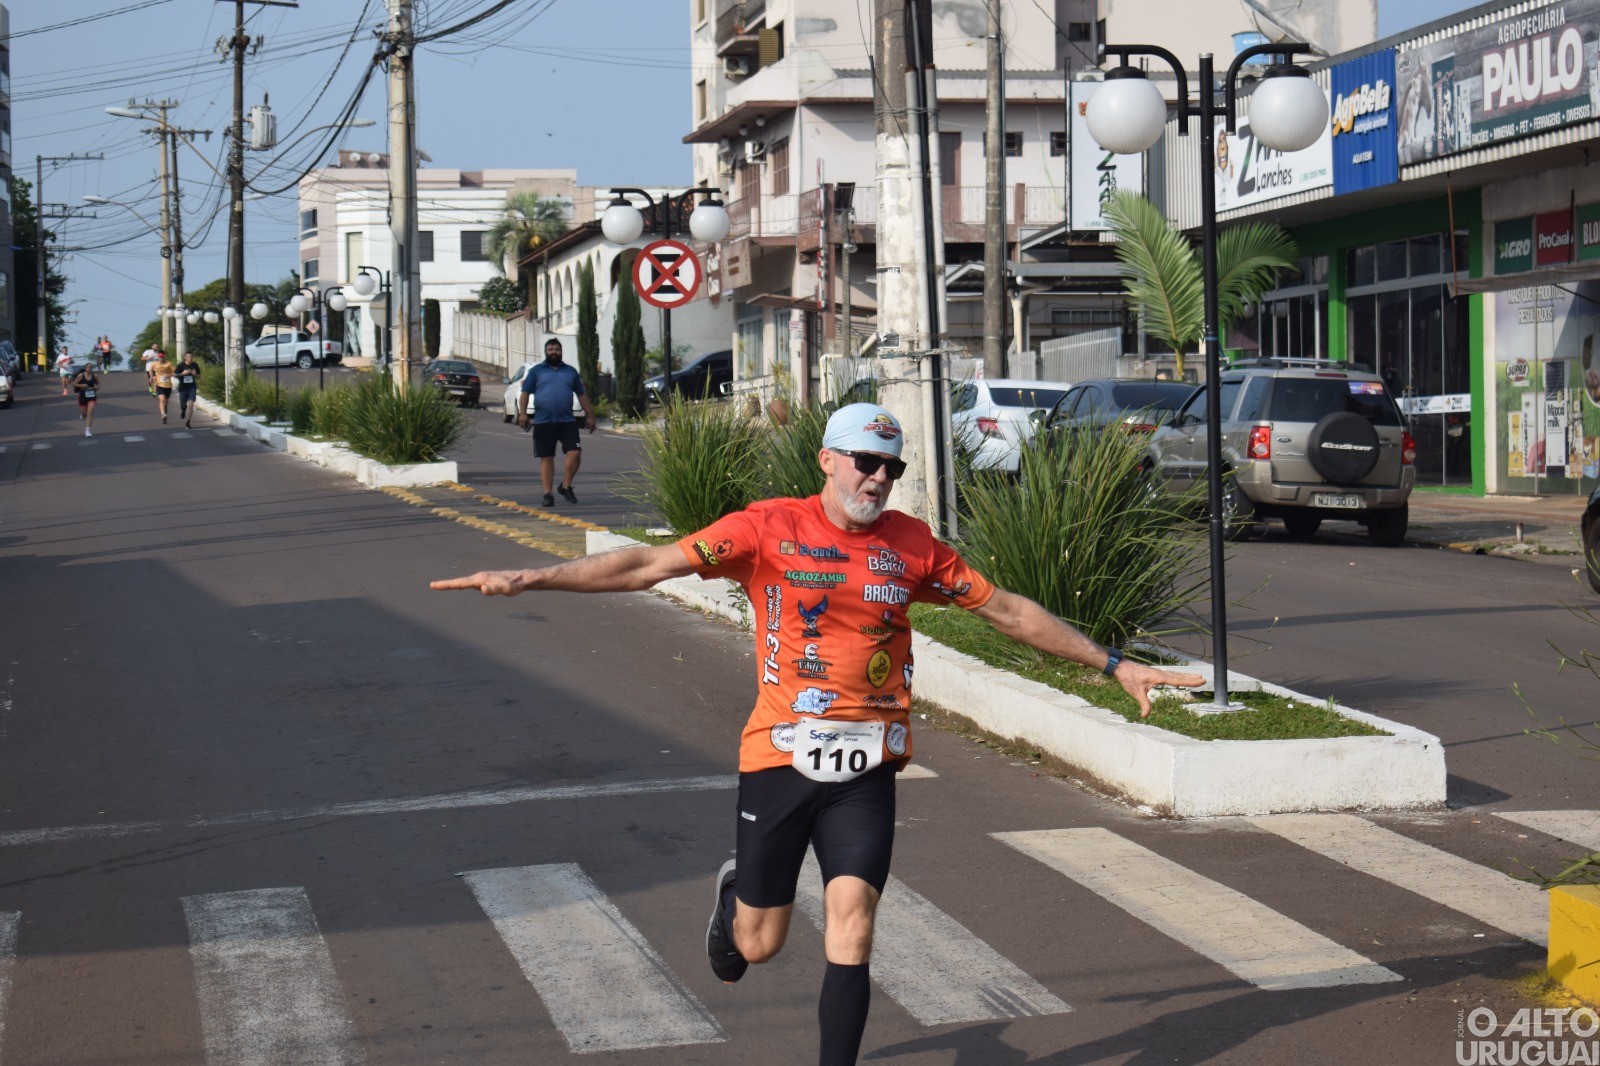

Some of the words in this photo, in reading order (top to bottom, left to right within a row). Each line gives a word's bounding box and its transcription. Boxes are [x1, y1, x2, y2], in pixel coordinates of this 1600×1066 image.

[1498, 7, 1566, 45] AGROPECUÁRIA
[1482, 27, 1583, 112] PAULO
[1333, 79, 1390, 129] AgroBella
[1493, 123, 1515, 140] MINERAIS
[1519, 119, 1529, 134] PET
[1534, 112, 1561, 130] FERRAGENS
[1566, 105, 1590, 122] DIVERSOS
[1256, 163, 1292, 192] Lanches
[1500, 239, 1531, 259] AGRO
[867, 556, 906, 575] Barril
[880, 550, 897, 562] Do
[785, 570, 847, 584] AGROZAMBI
[765, 585, 773, 597] de
[771, 585, 781, 631] Tecnologia
[809, 729, 840, 742] Sesc
[807, 747, 868, 773] 110
